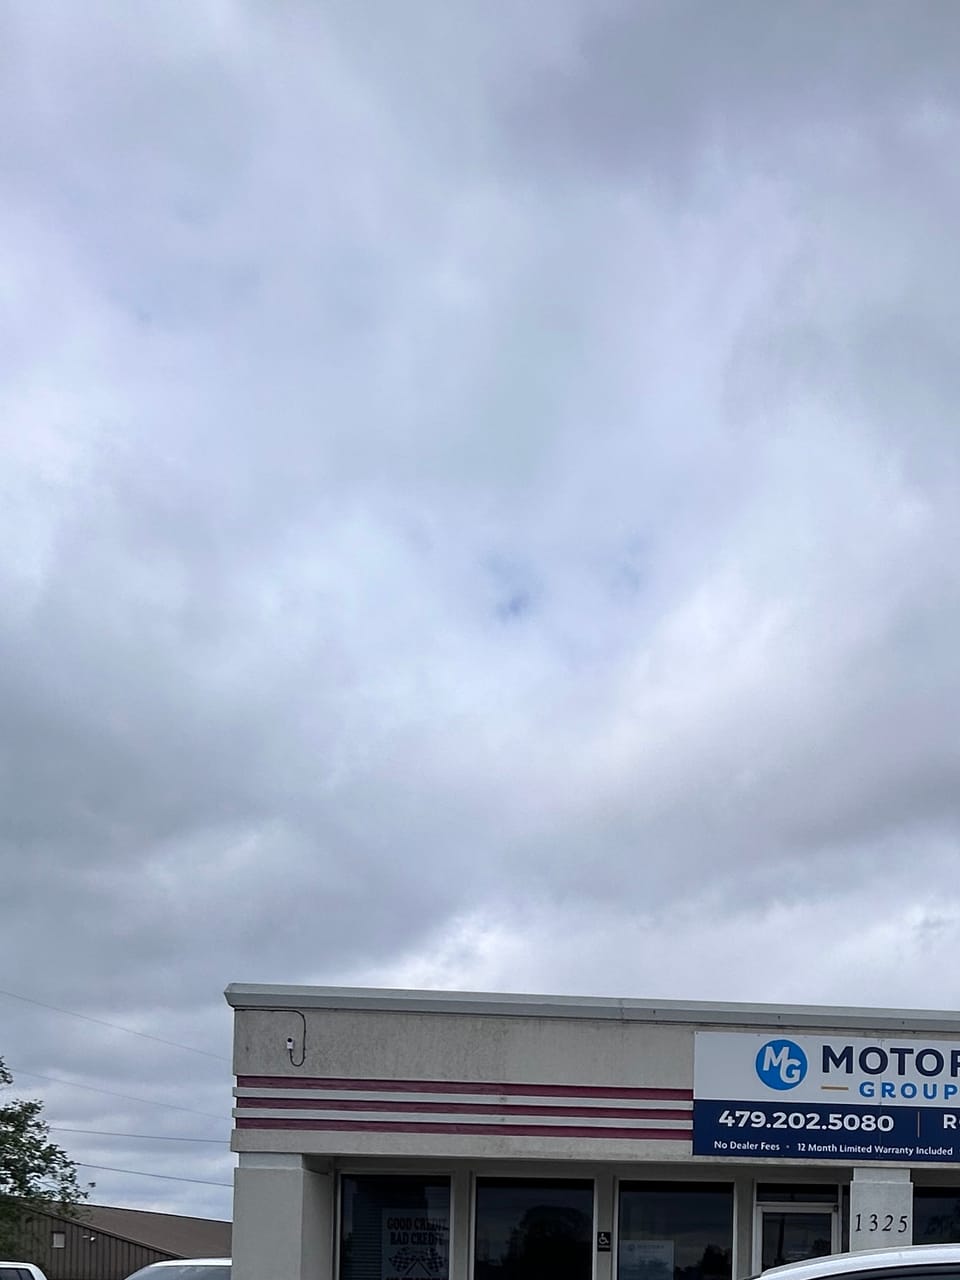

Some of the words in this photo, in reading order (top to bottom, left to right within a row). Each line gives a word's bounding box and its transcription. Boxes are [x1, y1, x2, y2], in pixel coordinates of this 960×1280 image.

[763, 1046, 801, 1084] MG
[859, 1081, 959, 1100] GROUP
[718, 1110, 895, 1132] 479.202.5080
[714, 1140, 728, 1149] No
[729, 1141, 759, 1150] Dealer
[760, 1142, 780, 1151] Fees
[797, 1143, 806, 1152] 12
[808, 1143, 837, 1152] Month
[839, 1144, 872, 1153] Limited
[874, 1145, 913, 1156] Warranty
[916, 1146, 953, 1155] Included
[387, 1217, 412, 1230] GOOD
[856, 1213, 908, 1233] 1325
[390, 1232, 409, 1245] BAD
